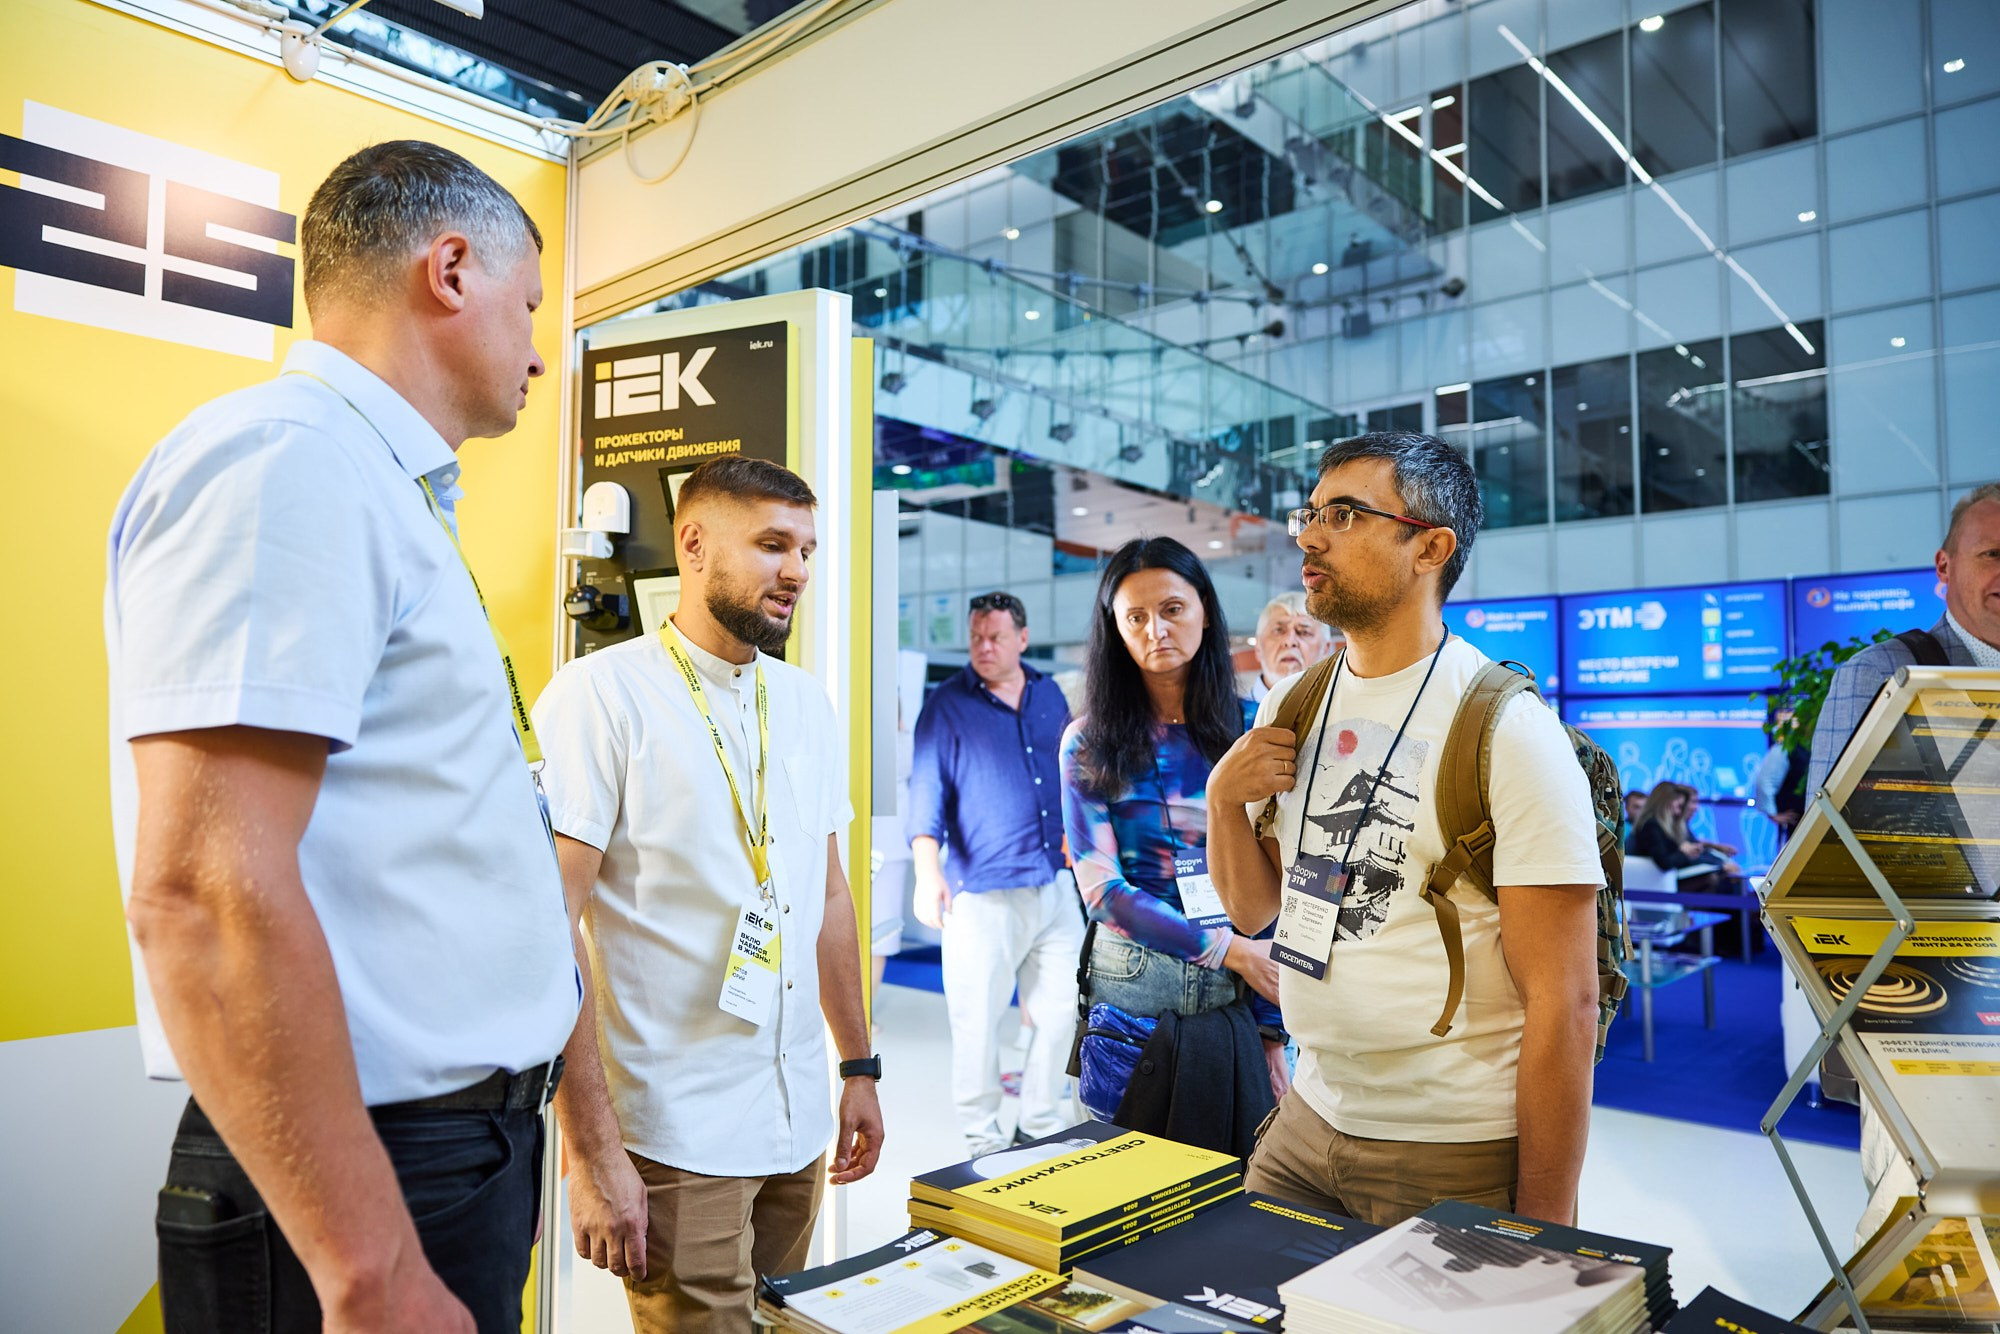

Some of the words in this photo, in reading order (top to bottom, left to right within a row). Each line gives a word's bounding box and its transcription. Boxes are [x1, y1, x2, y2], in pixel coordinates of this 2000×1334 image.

[0, 133, 296, 328] 25
[749, 340, 773, 350] iek.ru
[595, 428, 683, 449] ПРОЖЕКТОРЫ
[595, 455, 604, 467] И
[605, 447, 665, 468] ДАТЧИКИ
[666, 439, 741, 461] ДВИЖЕНИЯ
[1578, 606, 1633, 630] ЭТМ
[505, 655, 530, 732] ВКЛЮЧАЕМСЯ
[1934, 700, 2000, 709] АССОРТ
[1174, 858, 1203, 866] Форум
[1176, 866, 1194, 874] ЭТМ
[1294, 864, 1318, 880] Форум
[1291, 874, 1307, 887] ЭТМ
[1199, 916, 1231, 926] ПОСЕТИТЕ
[740, 932, 761, 946] ВКЛЮ
[1279, 929, 1289, 940] SA
[739, 938, 768, 956] ЧАЕМСЯ
[743, 948, 771, 965] ЖИЗНЬ!
[1279, 950, 1314, 971] ПОСЕТИТЕЛЬ
[1897, 1046, 1920, 1054] ВСЕЙ
[1914, 1039, 1949, 1047] ЕДИНОЙ
[1951, 1040, 1995, 1048] СВЕТОВОЙ
[982, 1139, 1147, 1195] СВЕТОТЕХНИКА
[1150, 1181, 1192, 1202] СВЕТОТЕХНИКА
[1123, 1201, 1139, 1213] 2024
[1150, 1198, 1191, 1219] СВЕТОТЕХНИКА
[1122, 1219, 1138, 1231] 2024
[1152, 1212, 1195, 1234] СВЕТОТЕХНИКА
[1123, 1234, 1140, 1246] 2024
[943, 1273, 1043, 1319] ОСВЕЩЕНИЕ
[979, 1276, 1054, 1312] УЛИЧНОЕ
